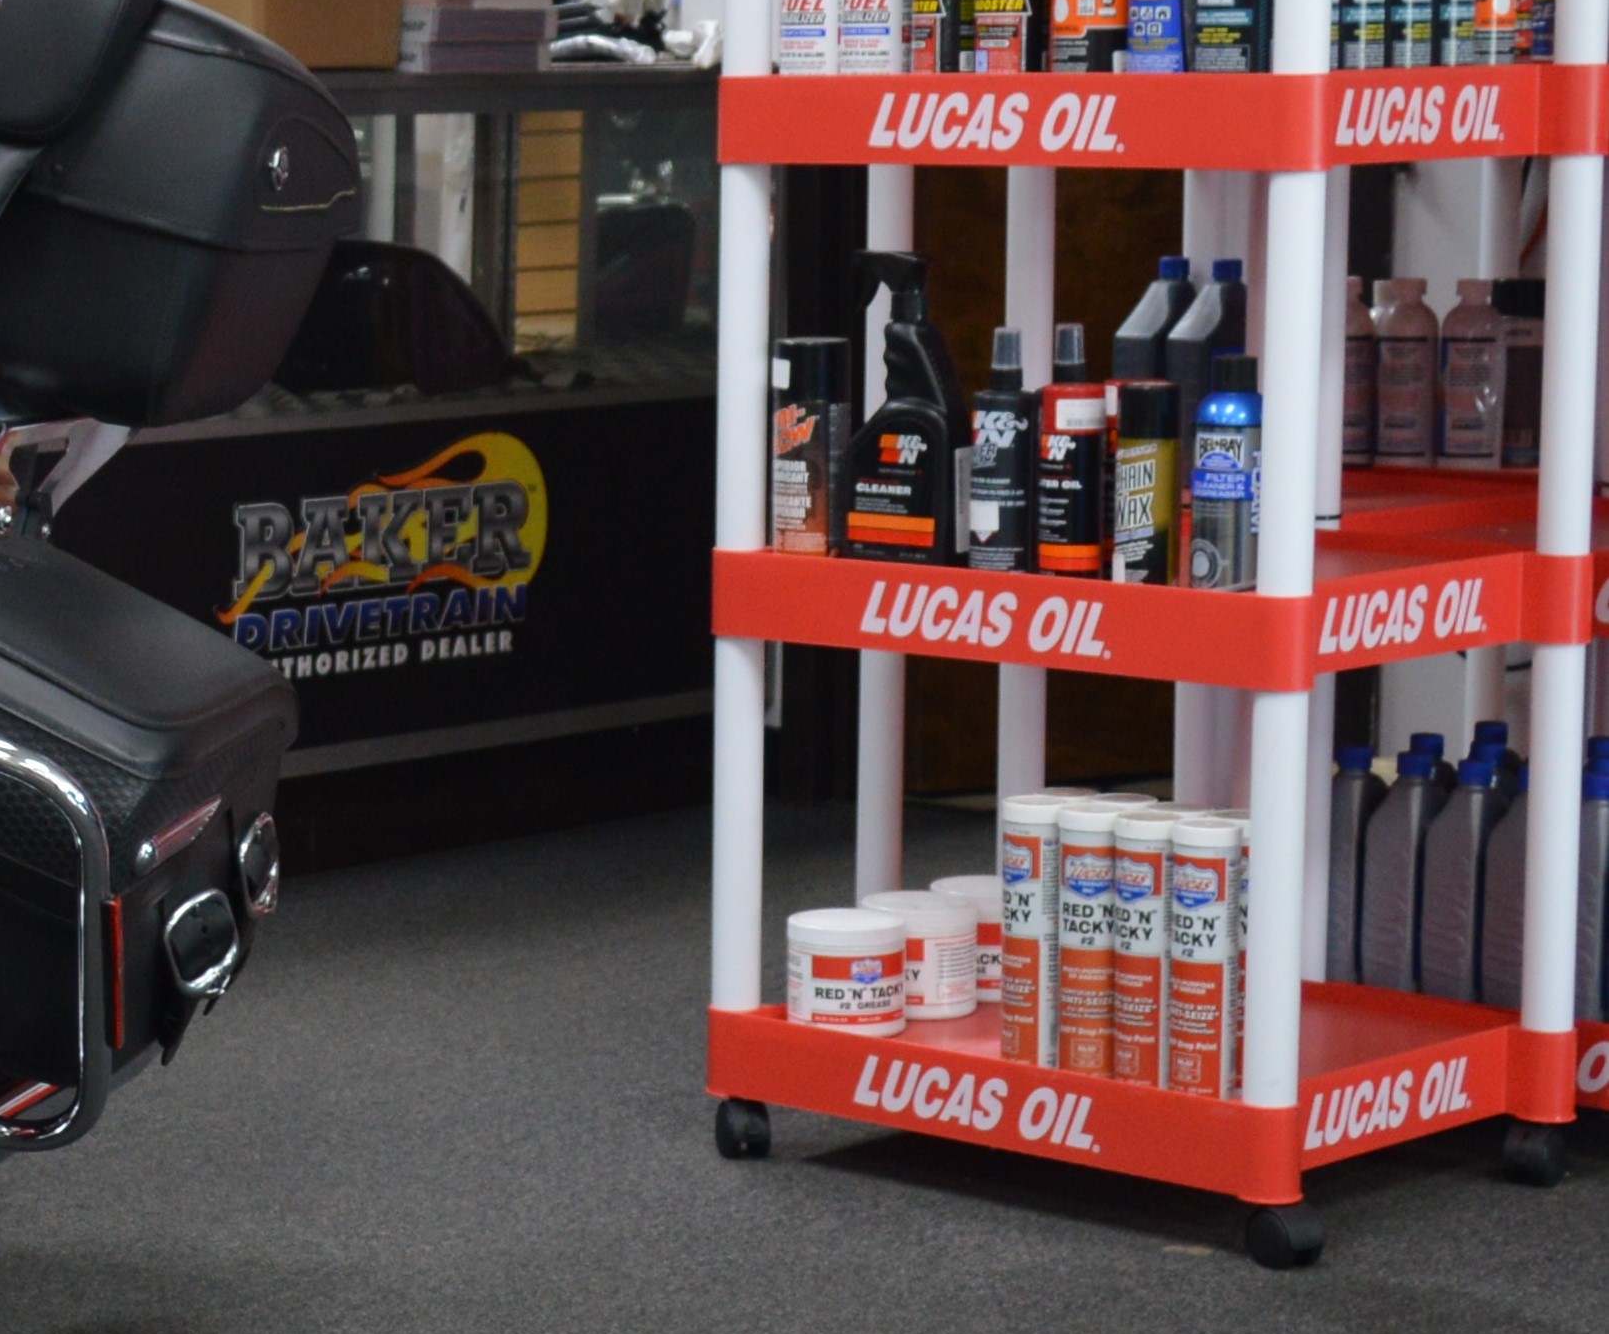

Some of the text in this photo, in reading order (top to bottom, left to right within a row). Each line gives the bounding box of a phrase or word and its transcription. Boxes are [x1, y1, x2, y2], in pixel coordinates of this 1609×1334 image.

[868, 91, 1118, 152] LUCAS OIL
[1335, 84, 1504, 146] LUCAS OIL
[855, 482, 912, 496] CLEANER
[232, 480, 533, 602] BAKER
[234, 583, 528, 652] DRIVETRAIN
[860, 580, 1104, 656] LUCAS OIL
[1318, 578, 1487, 654] LUCAS OIL
[271, 630, 514, 679] THORIZED DEALER
[1061, 901, 1095, 919] RED
[814, 987, 846, 1001] RED
[854, 1055, 1093, 1149] LUCAS OIL
[1304, 1056, 1467, 1150] LUCAS OIL
